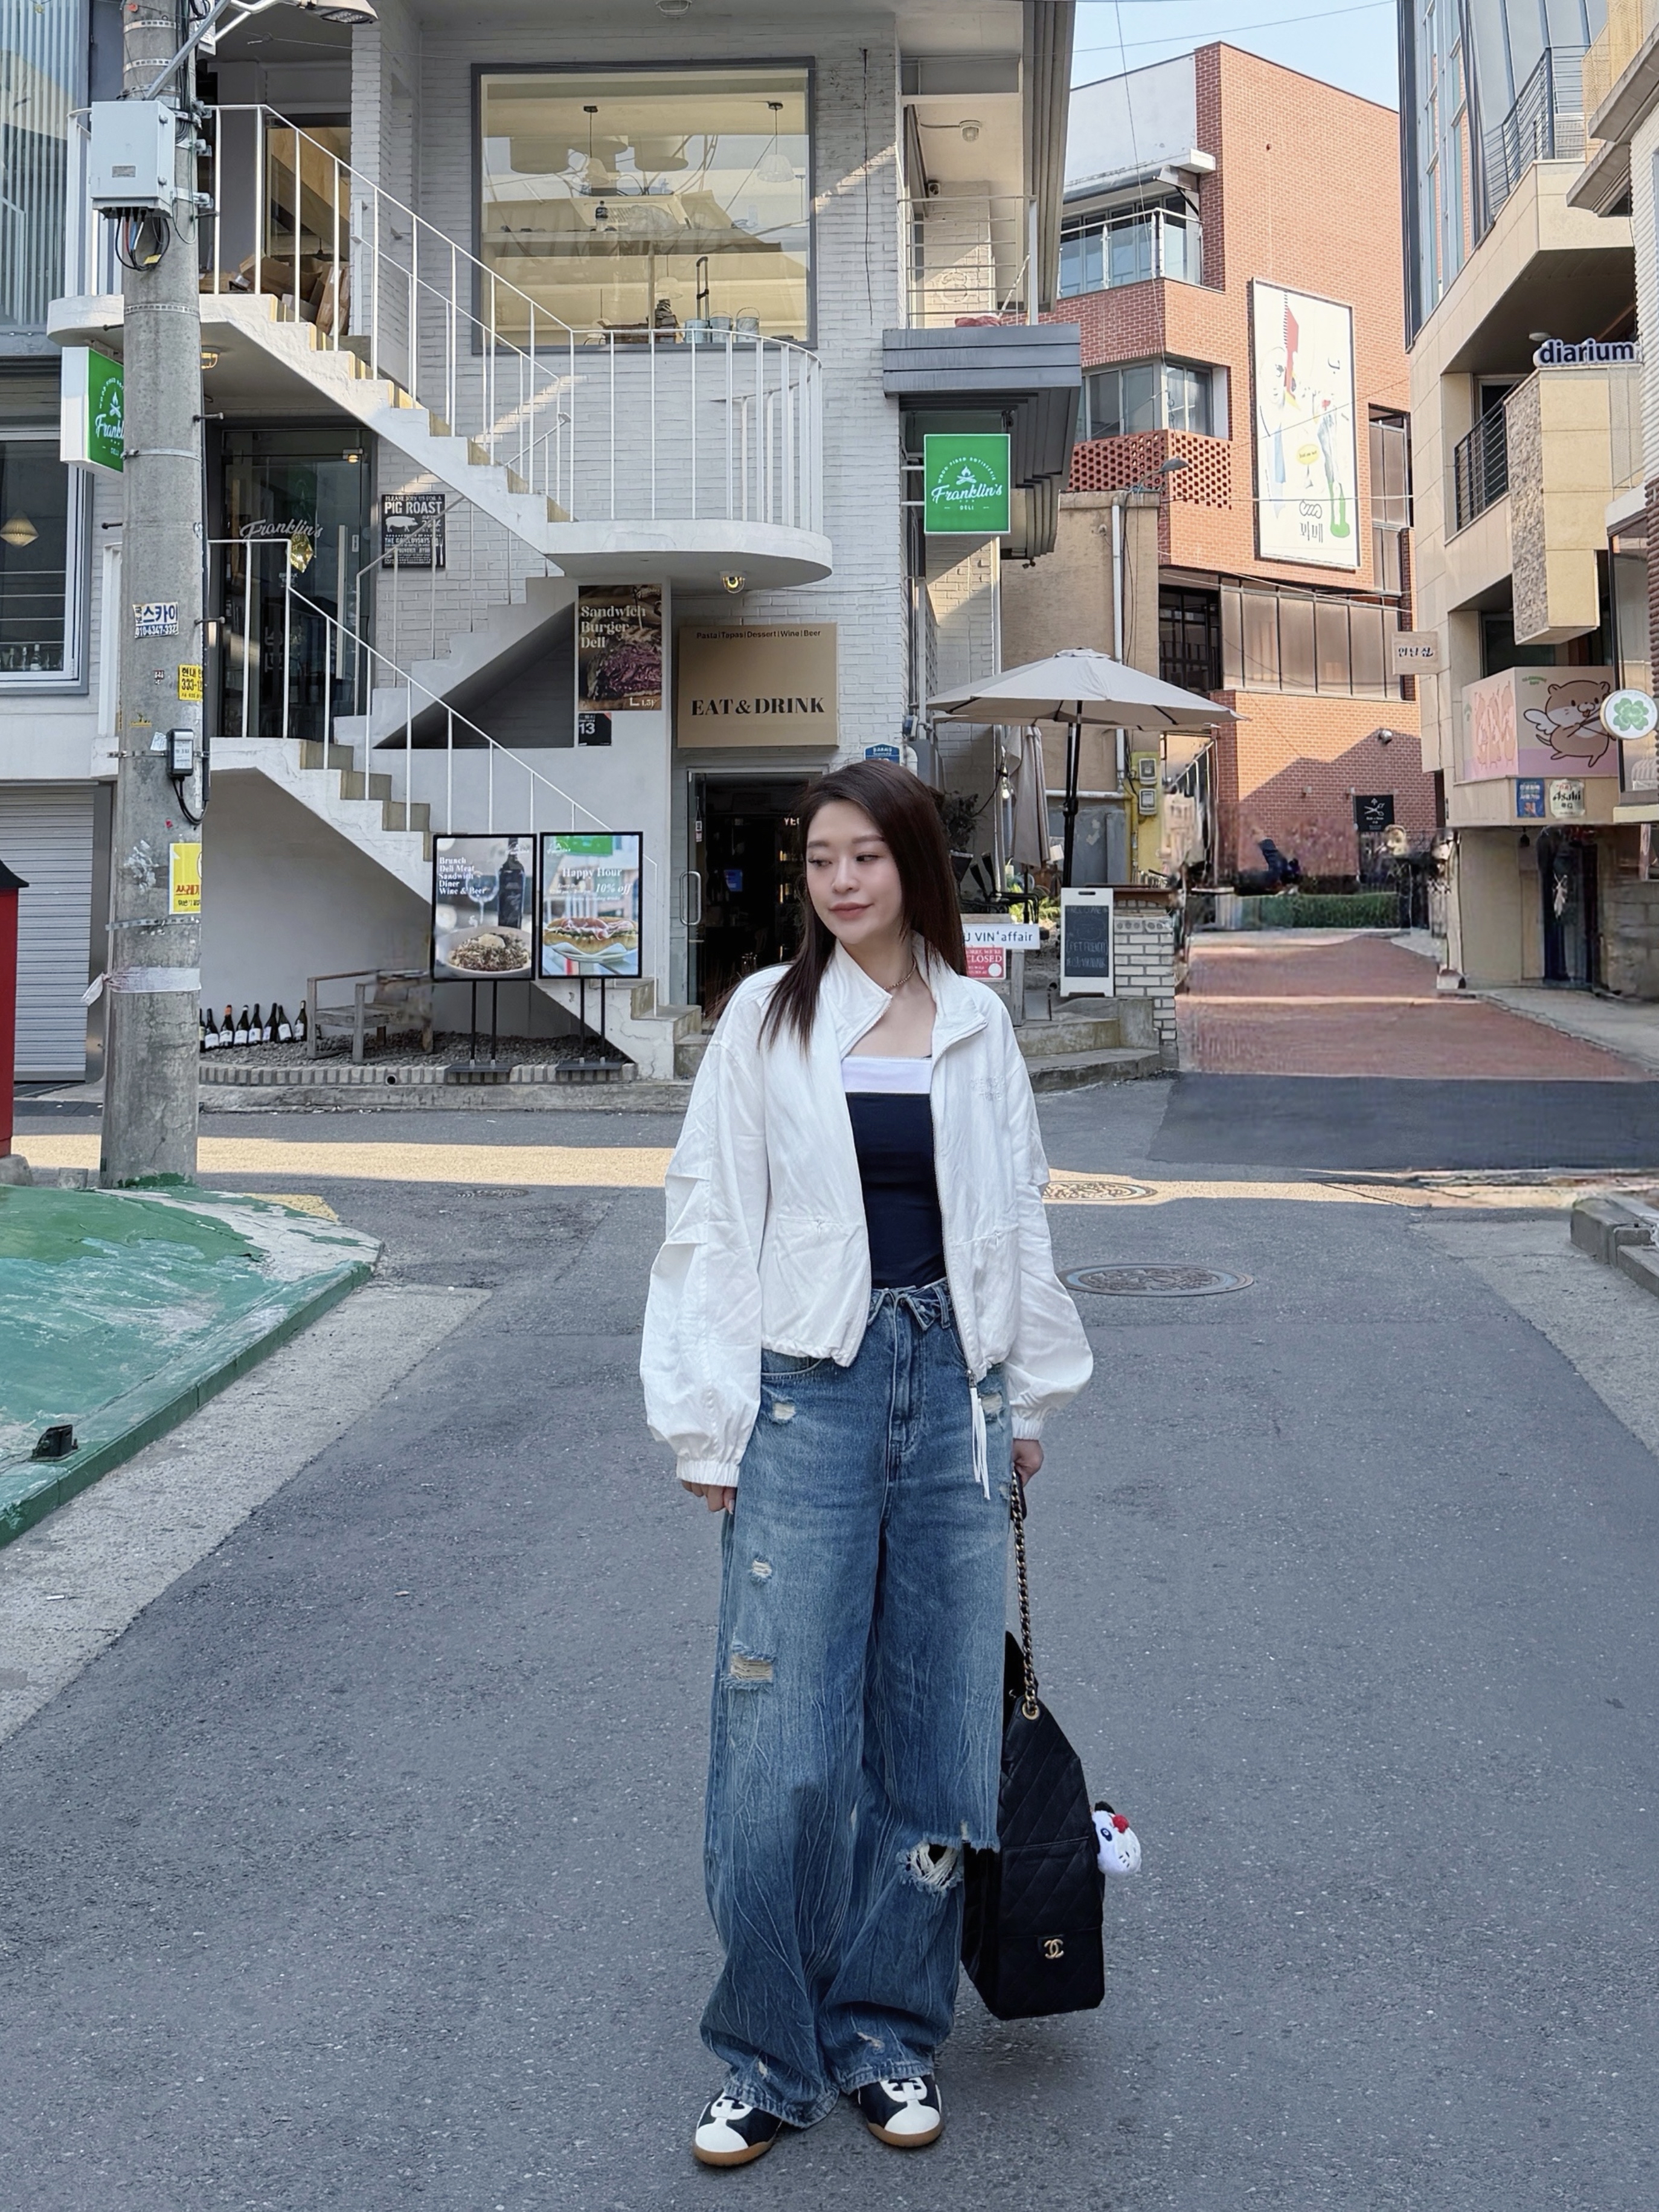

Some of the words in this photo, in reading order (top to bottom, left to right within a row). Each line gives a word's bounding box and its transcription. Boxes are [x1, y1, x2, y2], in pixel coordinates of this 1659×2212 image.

[1540, 340, 1634, 364] diarium
[949, 457, 966, 466] FIRED
[931, 483, 1003, 504] Franklin's
[385, 501, 402, 514] PIG
[406, 501, 442, 514] ROAST
[143, 605, 178, 623] 스카이
[581, 605, 646, 617] Sandwich
[581, 622, 629, 635] Burger
[581, 637, 605, 648] Deli
[579, 722, 595, 735] 13
[1552, 790, 1581, 801] Asahi
[562, 867, 594, 879] Happy
[597, 867, 622, 876] Hour
[596, 883, 616, 893] 10%
[617, 883, 633, 895] off
